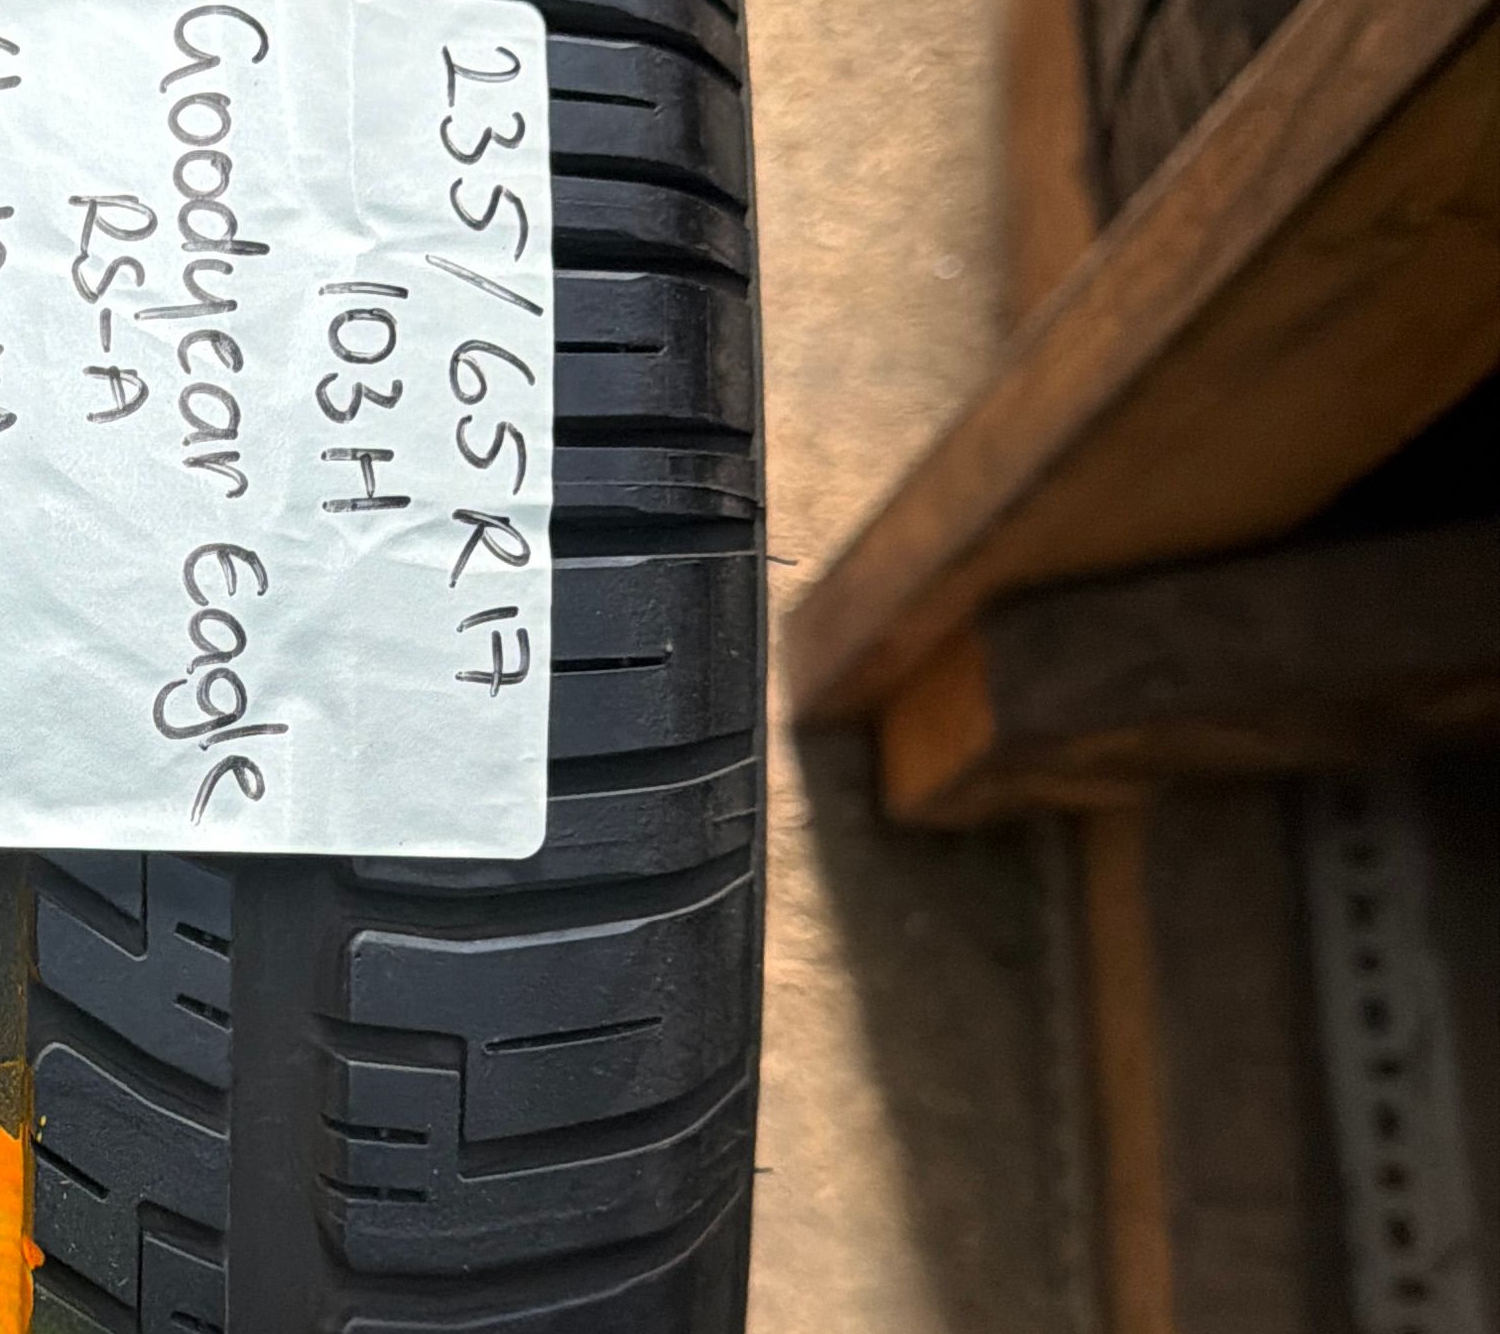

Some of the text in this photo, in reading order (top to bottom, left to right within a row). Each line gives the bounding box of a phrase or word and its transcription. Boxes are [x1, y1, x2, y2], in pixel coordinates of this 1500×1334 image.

[68, 193, 160, 424] RS-A
[133, 3, 288, 826] Goodyear Eagle
[315, 278, 411, 514] 103H
